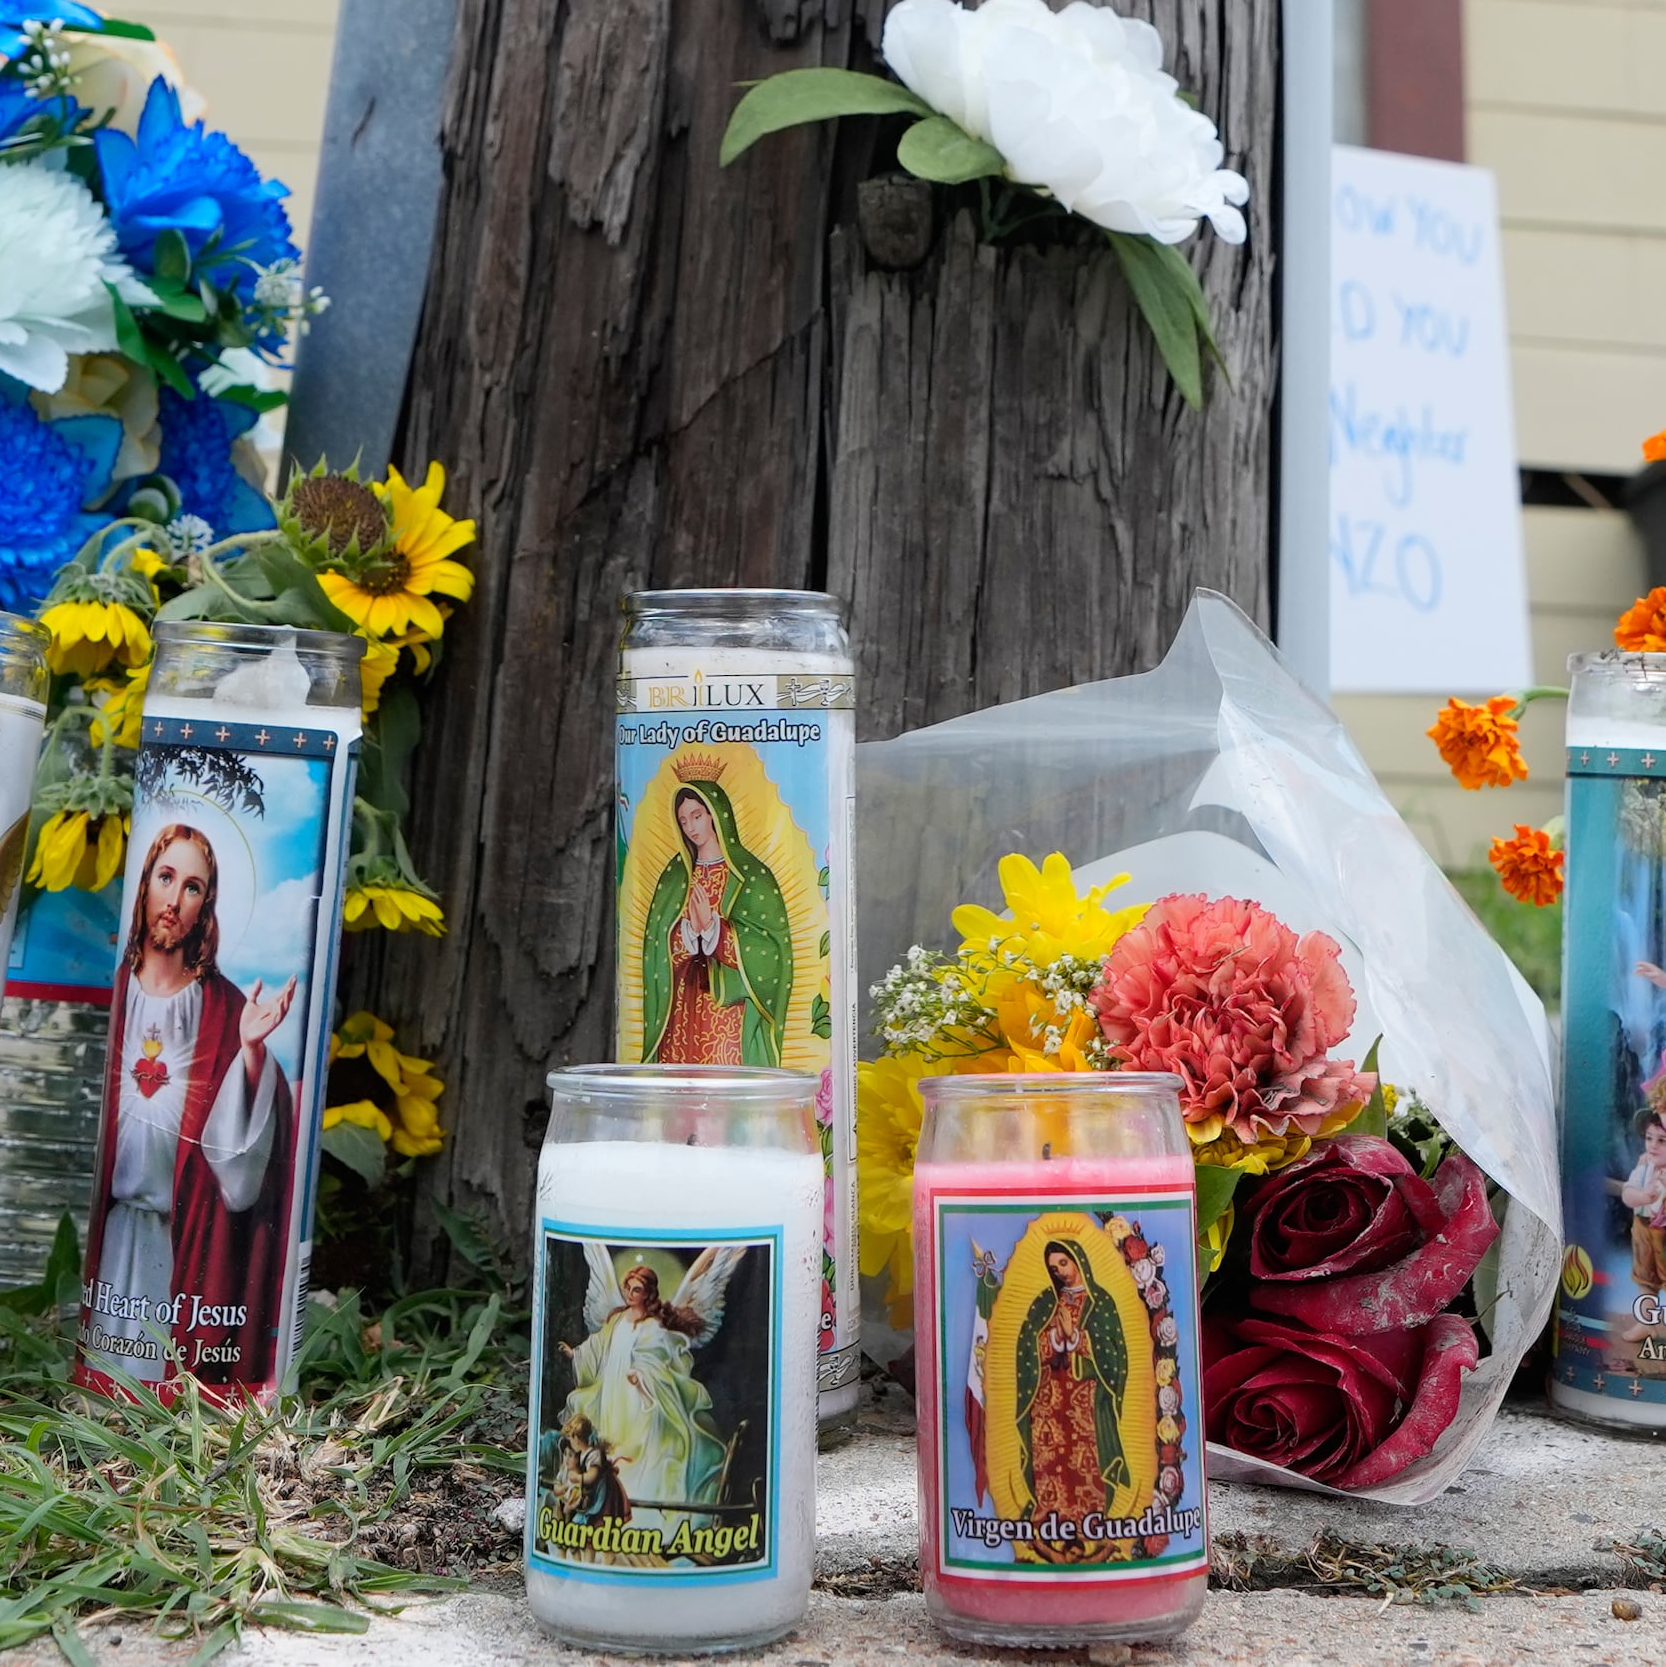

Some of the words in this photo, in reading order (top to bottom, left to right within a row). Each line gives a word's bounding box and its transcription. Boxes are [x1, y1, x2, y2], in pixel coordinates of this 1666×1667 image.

[619, 724, 638, 746] Our
[638, 720, 680, 750] Lady
[681, 719, 711, 744] of
[710, 717, 822, 748] Guadalupe
[94, 1281, 152, 1322] Heart
[155, 1292, 187, 1325] of
[185, 1295, 248, 1333] Jesus
[91, 1324, 159, 1361] Corazón
[162, 1337, 188, 1363] de
[191, 1338, 242, 1368] Jesús
[537, 1505, 665, 1556] Guardian
[664, 1512, 761, 1560] Angel
[950, 1506, 1035, 1549] Virgen
[1038, 1511, 1080, 1541] de
[1081, 1503, 1203, 1540] Guadalupe
